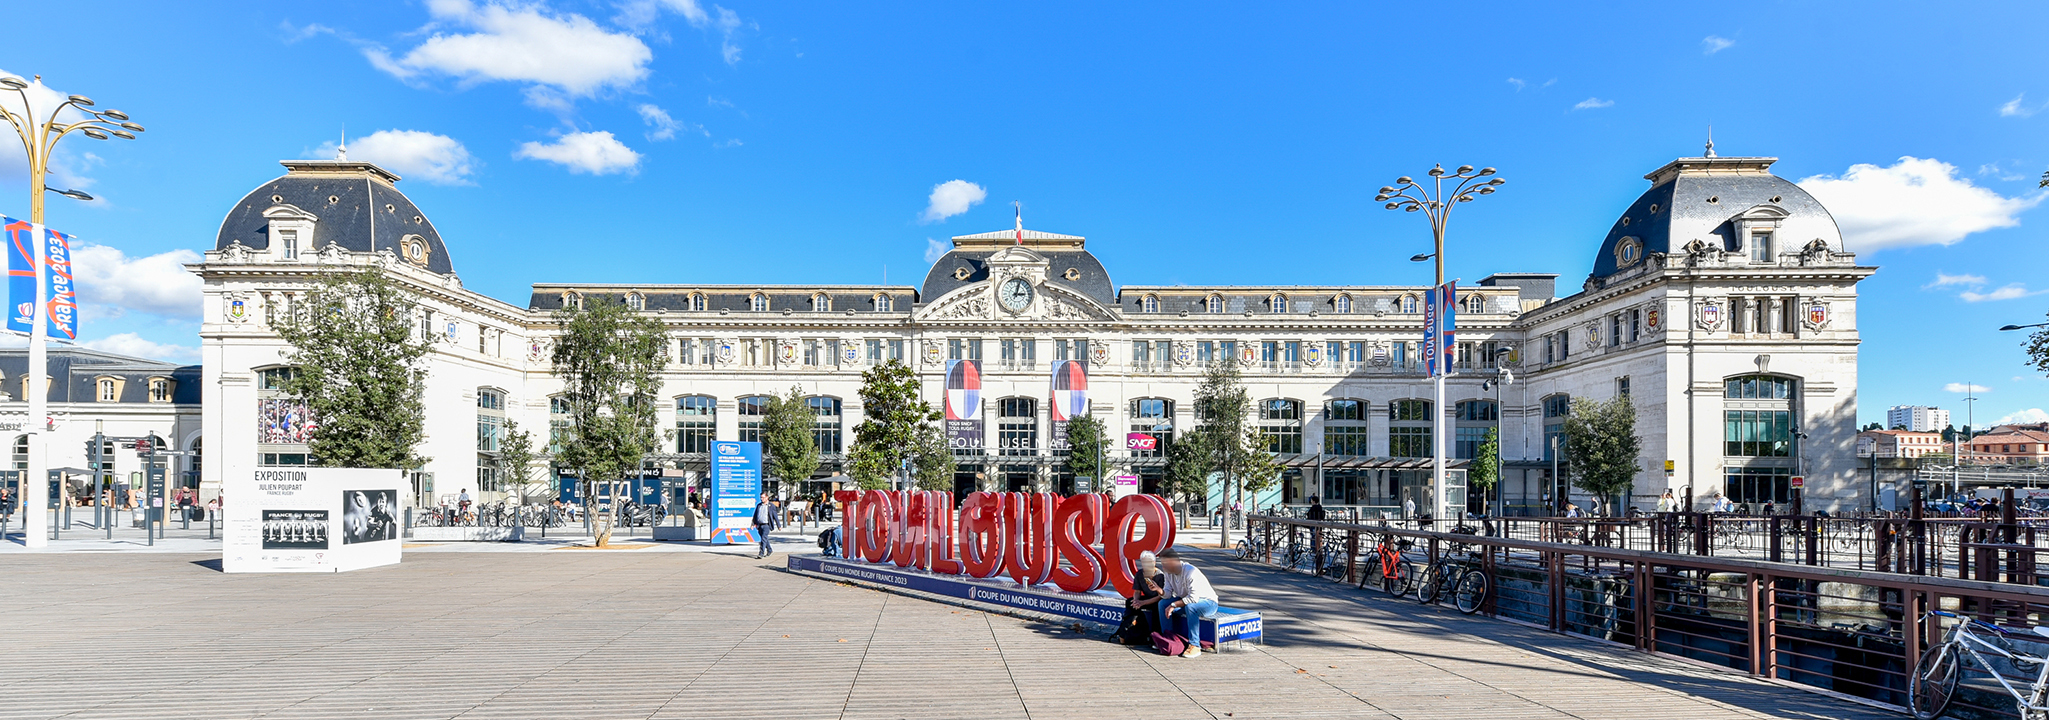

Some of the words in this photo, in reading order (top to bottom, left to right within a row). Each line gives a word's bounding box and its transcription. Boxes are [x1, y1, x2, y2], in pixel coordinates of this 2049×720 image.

[49, 237, 67, 273] 2023
[1127, 439, 1154, 447] SNCF
[254, 470, 307, 481] EXPOSITION
[258, 483, 277, 491] JULIEN
[277, 483, 302, 491] POUPART
[824, 564, 838, 573] COUPE
[838, 566, 845, 574] DU
[844, 567, 861, 576] MONDE
[860, 569, 876, 579] RUGBY
[875, 572, 894, 582] FRANCE
[894, 576, 908, 585] 2023
[977, 589, 999, 601] COUPE
[1000, 593, 1010, 602] DU
[1011, 595, 1038, 608] MONDE
[1039, 599, 1065, 612] RUGBY
[1066, 603, 1098, 617] FRANCE
[1100, 608, 1123, 622] 2023
[1219, 620, 1261, 638] #RWC2023
